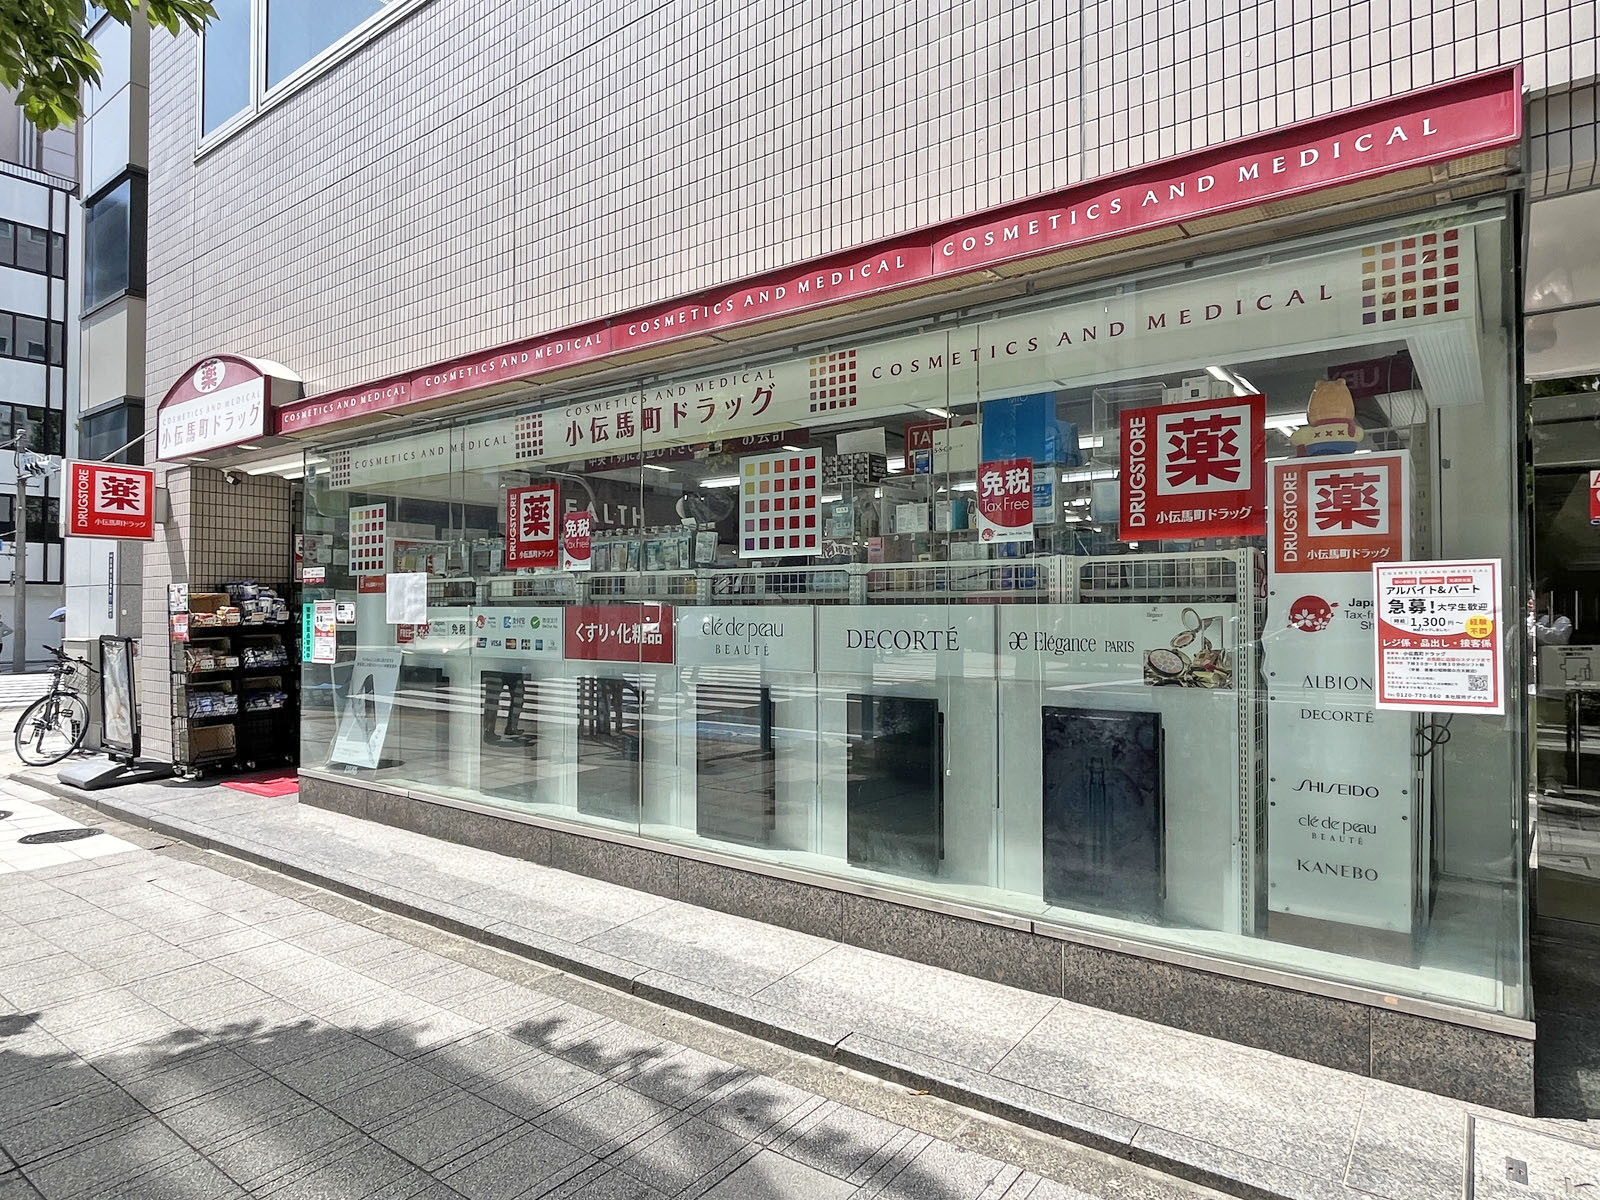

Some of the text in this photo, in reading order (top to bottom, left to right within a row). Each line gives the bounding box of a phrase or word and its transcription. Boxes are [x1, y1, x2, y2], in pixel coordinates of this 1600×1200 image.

[942, 118, 1438, 257] COSMETICS AND MEDICAL
[628, 255, 904, 336] COSMETICS AND MEDICAL
[872, 284, 1332, 379] COSMETICS AND MEDICAL
[201, 360, 218, 391] 薬
[425, 334, 601, 387] COSMETICS AND MEDICAL
[162, 390, 260, 426] COSMETICS AND MEDICAL
[284, 385, 406, 423] COSMETICS AND MEDICAL
[566, 369, 775, 417] COSMETICS AND MEDICAL
[161, 401, 261, 450] 小伝馬町ドラッグ
[566, 383, 776, 447] 小伝馬町ドラッグ
[355, 435, 508, 469] COSMETICS AND MEDICAL
[1165, 414, 1241, 487] 薬
[981, 467, 1031, 498] 免税
[1129, 416, 1146, 527] DRUGSTORE
[77, 469, 89, 527] DRUGSTORE
[100, 476, 140, 511] 薬
[982, 497, 1030, 512] Tax Free
[1315, 472, 1381, 530] 薬
[509, 493, 517, 560] DRUGSTORE
[523, 494, 551, 537] 薬
[565, 519, 590, 538] 免税
[1156, 505, 1252, 524] 小伝馬町ドラッグ
[1283, 472, 1298, 562] DRUGSTORE
[1307, 547, 1390, 561] 小伝馬町ドラッグ
[1437, 603, 1488, 612] 大学生歓迎
[702, 616, 784, 642] clé de peau
[846, 626, 960, 651] DECORTÉ
[1034, 631, 1097, 656] Elégance
[1105, 640, 1135, 653] PARIS
[715, 644, 770, 656] BEAUTÉ
[1302, 675, 1373, 691] ALBION
[1301, 709, 1374, 723] DECORTÉ
[1292, 779, 1379, 798] SHISEIDO
[1298, 814, 1377, 835] clé de peau
[1297, 859, 1378, 882] KANEBO
